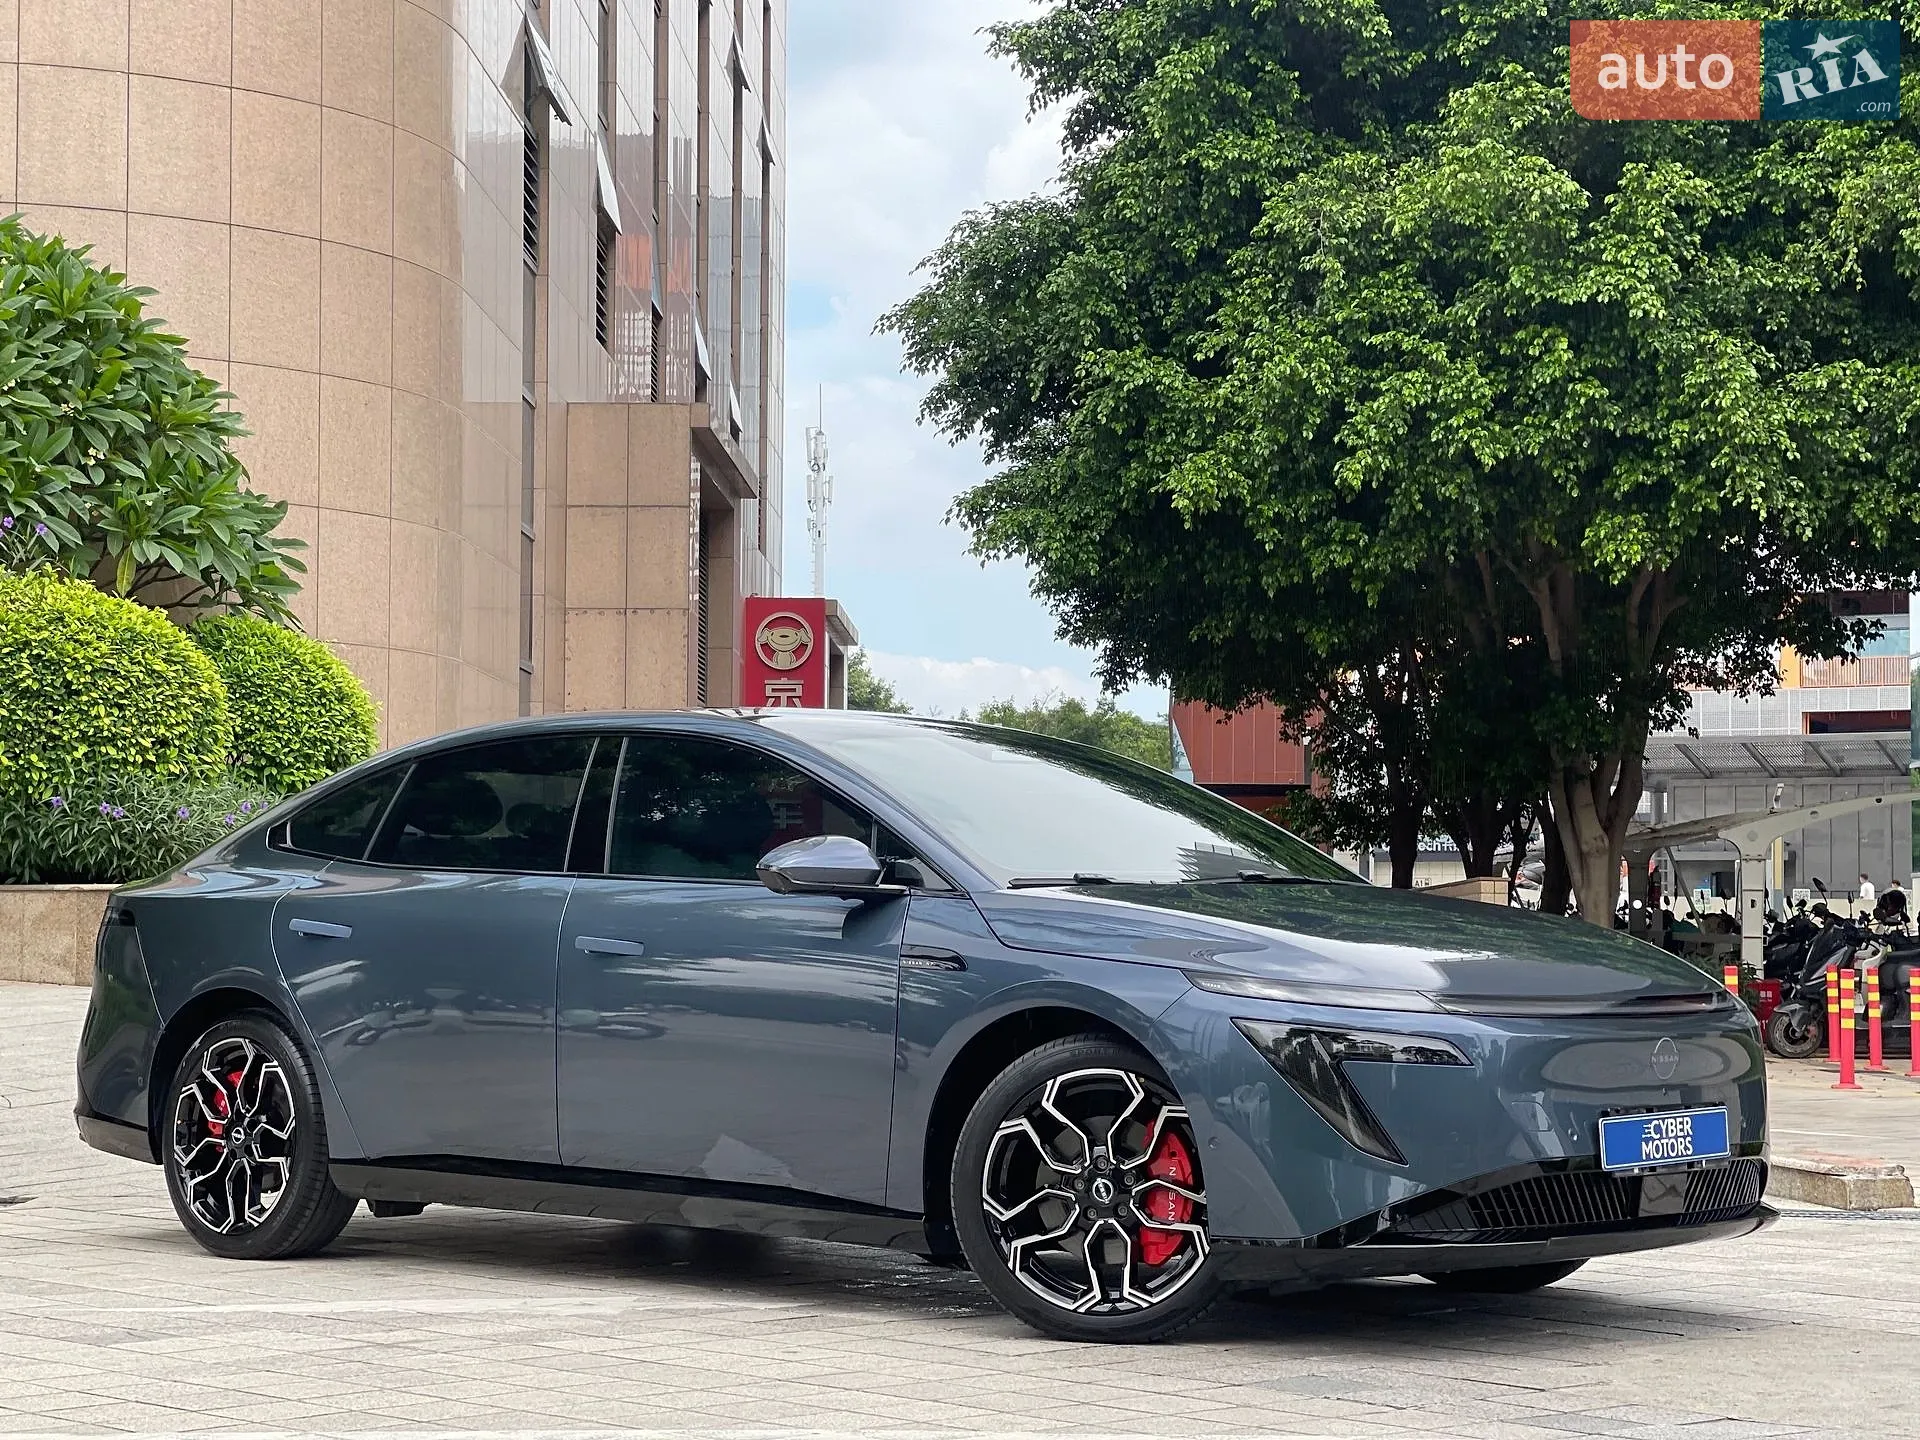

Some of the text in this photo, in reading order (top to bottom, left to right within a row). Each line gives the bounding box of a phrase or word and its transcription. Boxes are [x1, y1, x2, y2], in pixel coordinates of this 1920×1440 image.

[764, 677, 805, 708] 京
[1650, 1117, 1693, 1139] CYBER
[1641, 1136, 1694, 1160] MOTORS
[1168, 1166, 1176, 1221] NSAN
